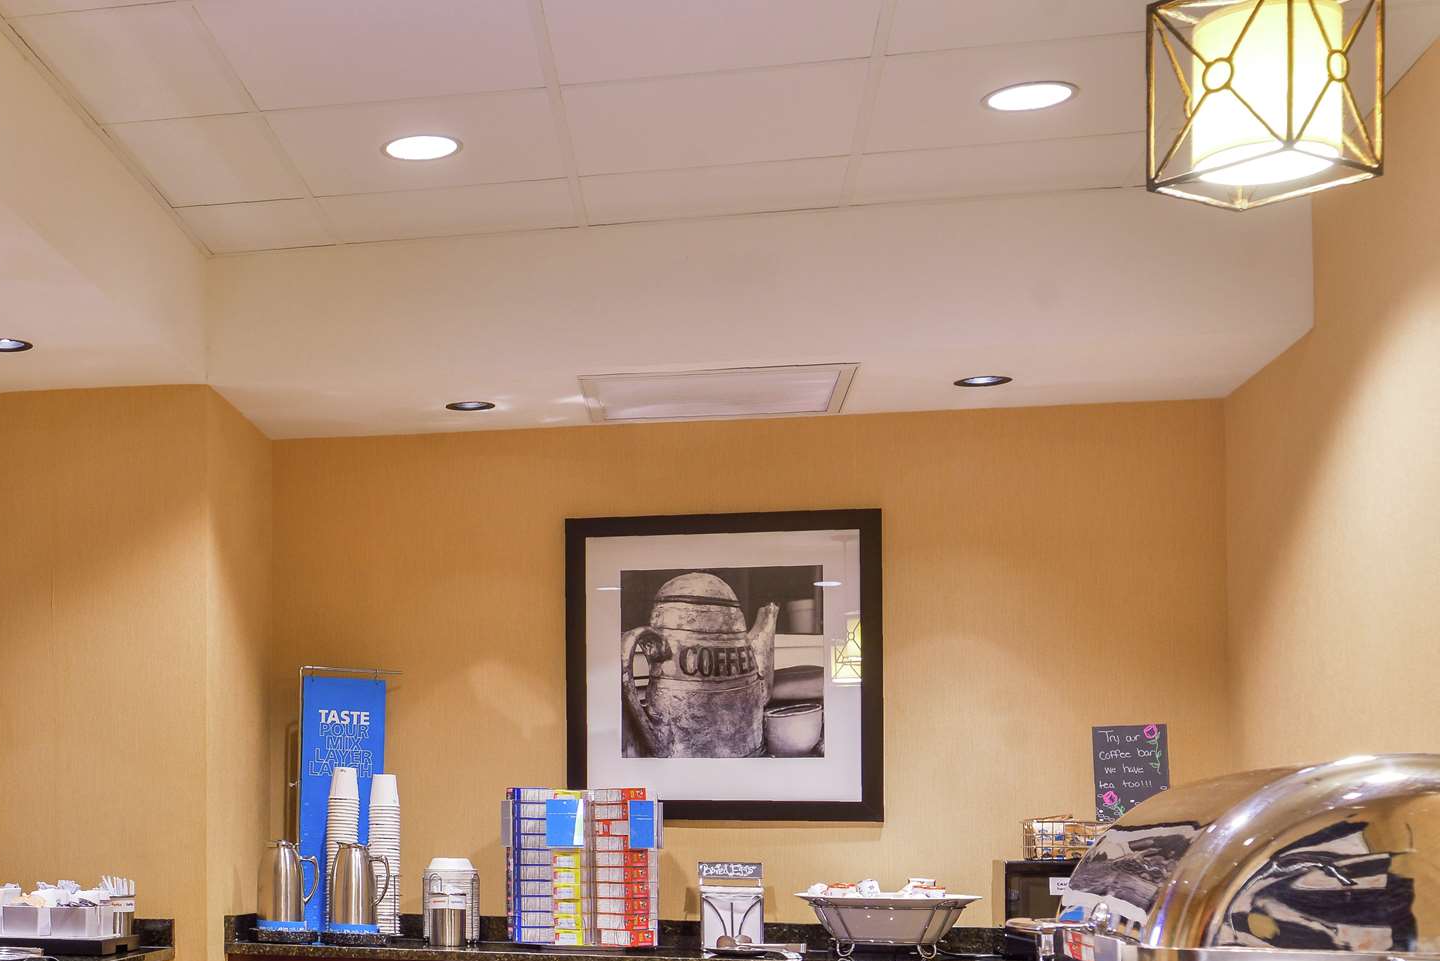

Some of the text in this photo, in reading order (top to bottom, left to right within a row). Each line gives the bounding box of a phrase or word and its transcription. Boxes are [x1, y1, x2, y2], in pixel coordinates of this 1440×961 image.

[679, 645, 756, 677] COFFEE
[318, 709, 370, 725] TASTE
[319, 722, 369, 739] POUR
[1098, 729, 1120, 744] Try
[325, 735, 362, 751] MIX
[314, 747, 373, 766] LAYER
[1122, 763, 1144, 774] have
[1099, 780, 1115, 789] tea
